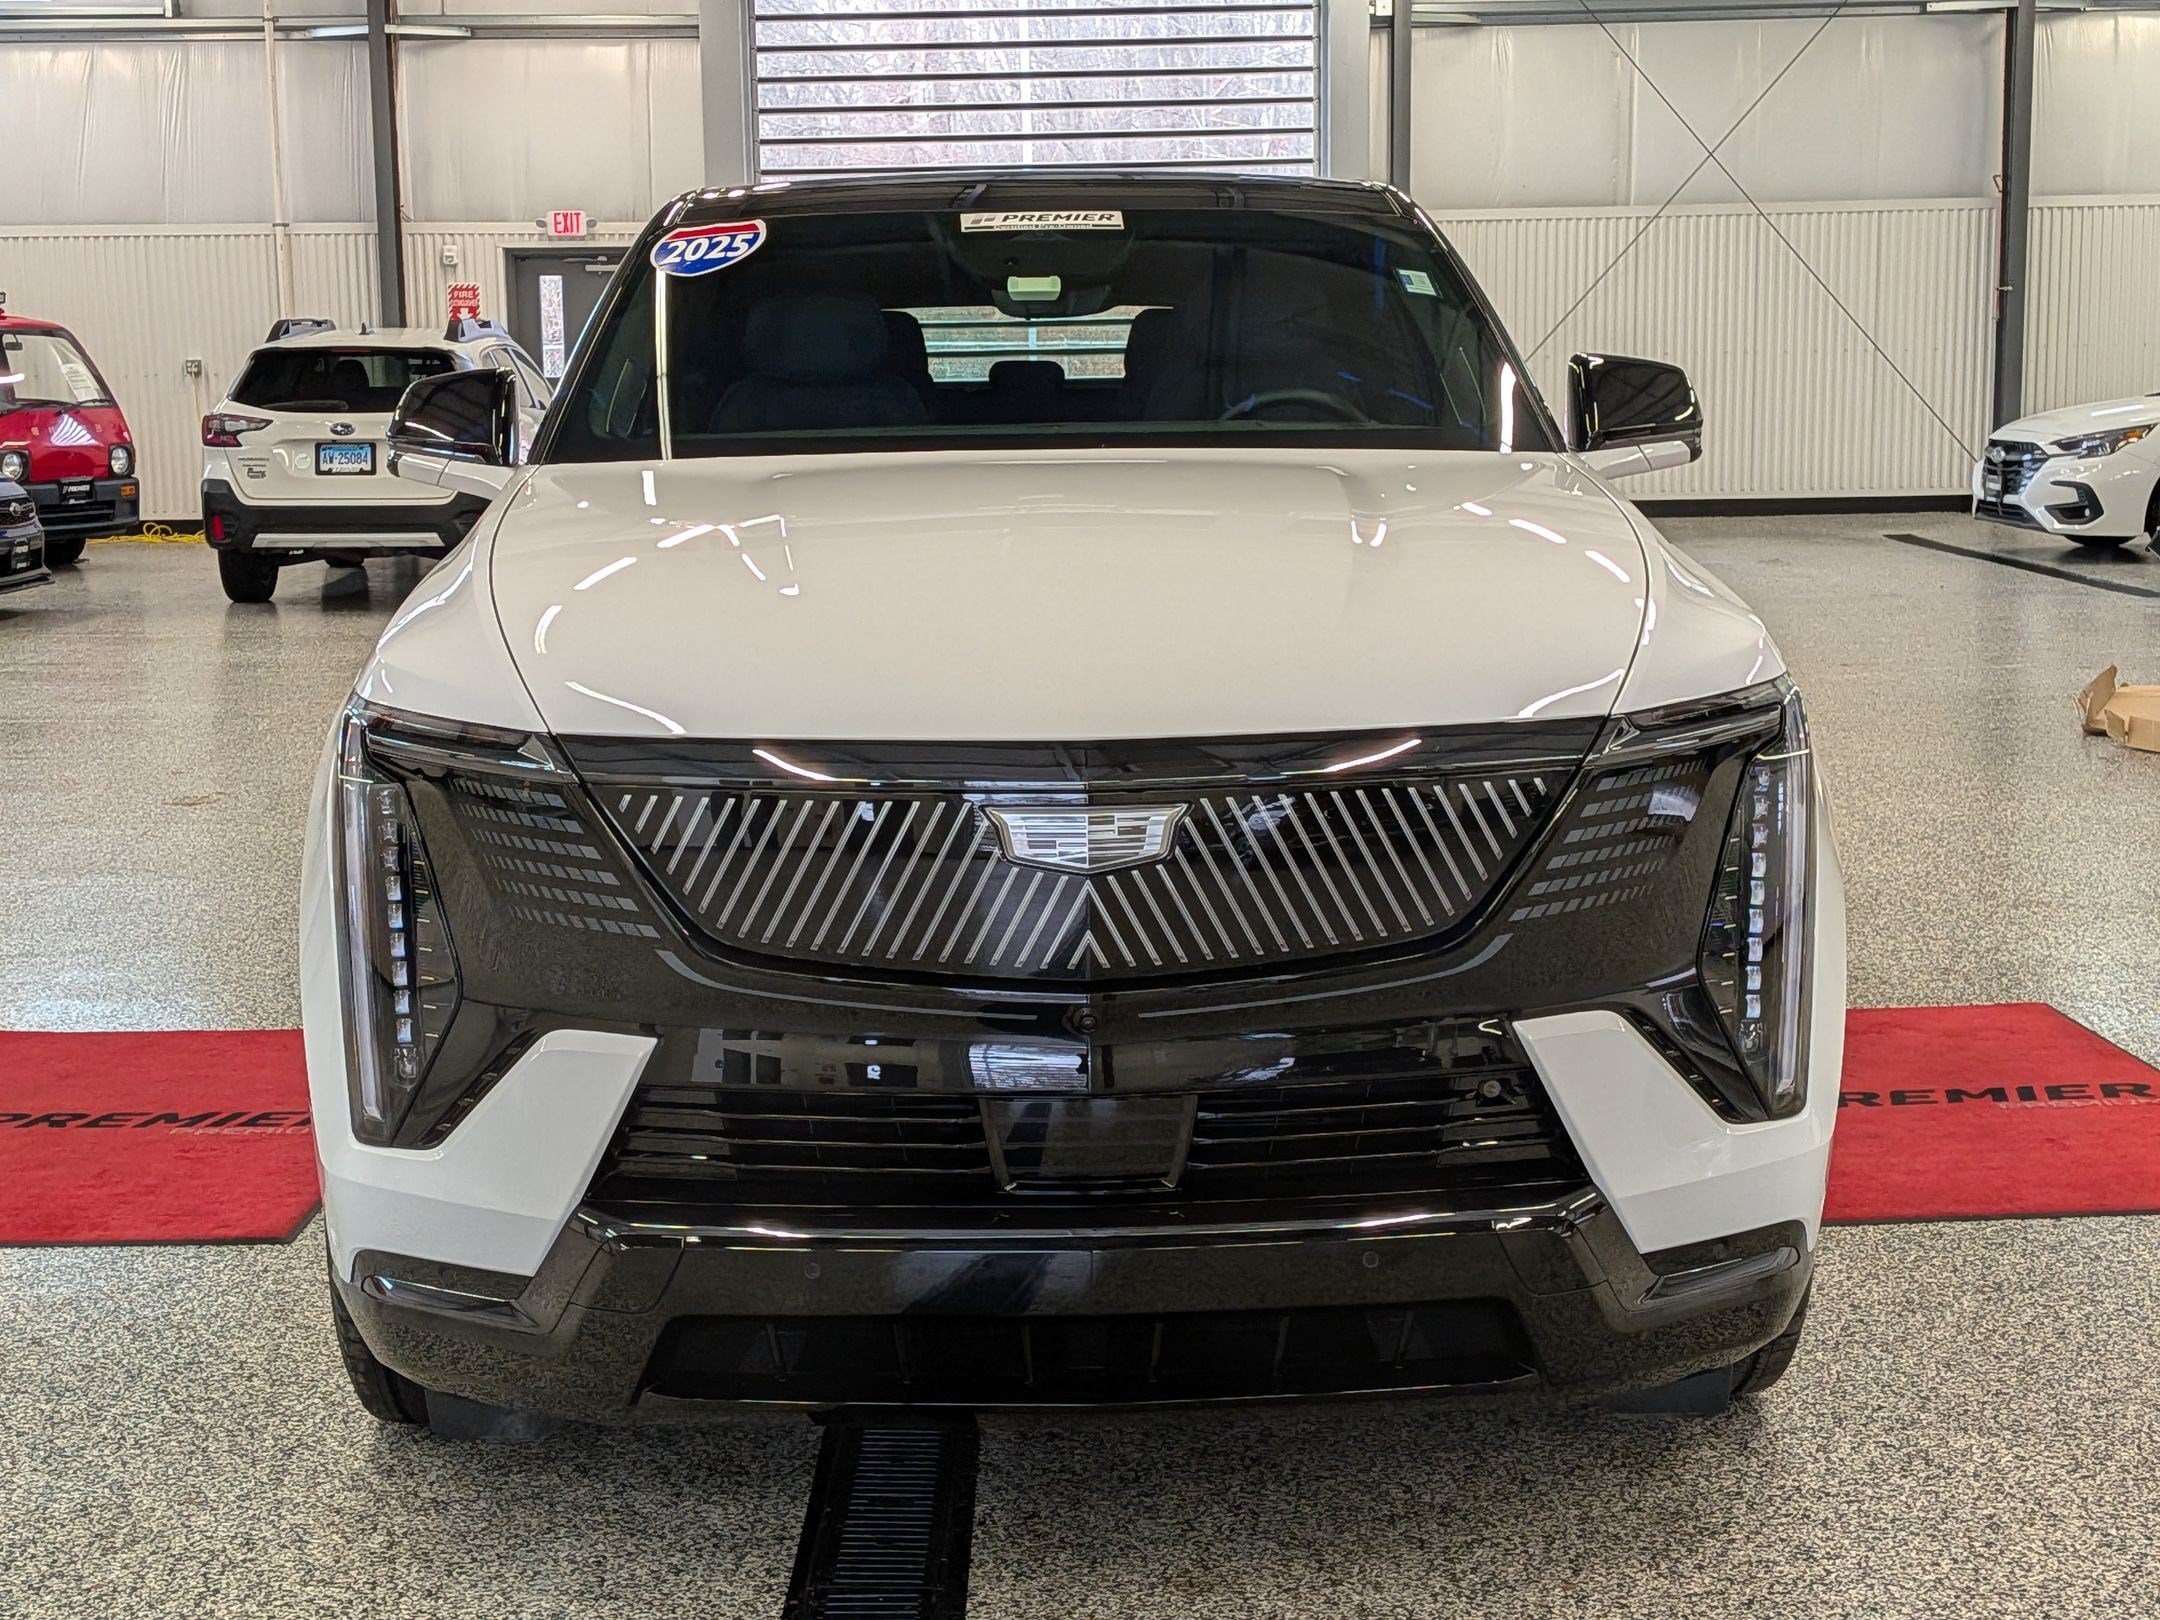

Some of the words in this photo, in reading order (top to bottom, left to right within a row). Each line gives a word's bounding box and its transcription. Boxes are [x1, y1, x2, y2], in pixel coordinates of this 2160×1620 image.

[554, 212, 581, 233] EXIT
[1001, 213, 1115, 223] PREMIER
[658, 233, 754, 265] 2025
[453, 290, 474, 299] FIRE
[1838, 1083, 2157, 1108] REMIER
